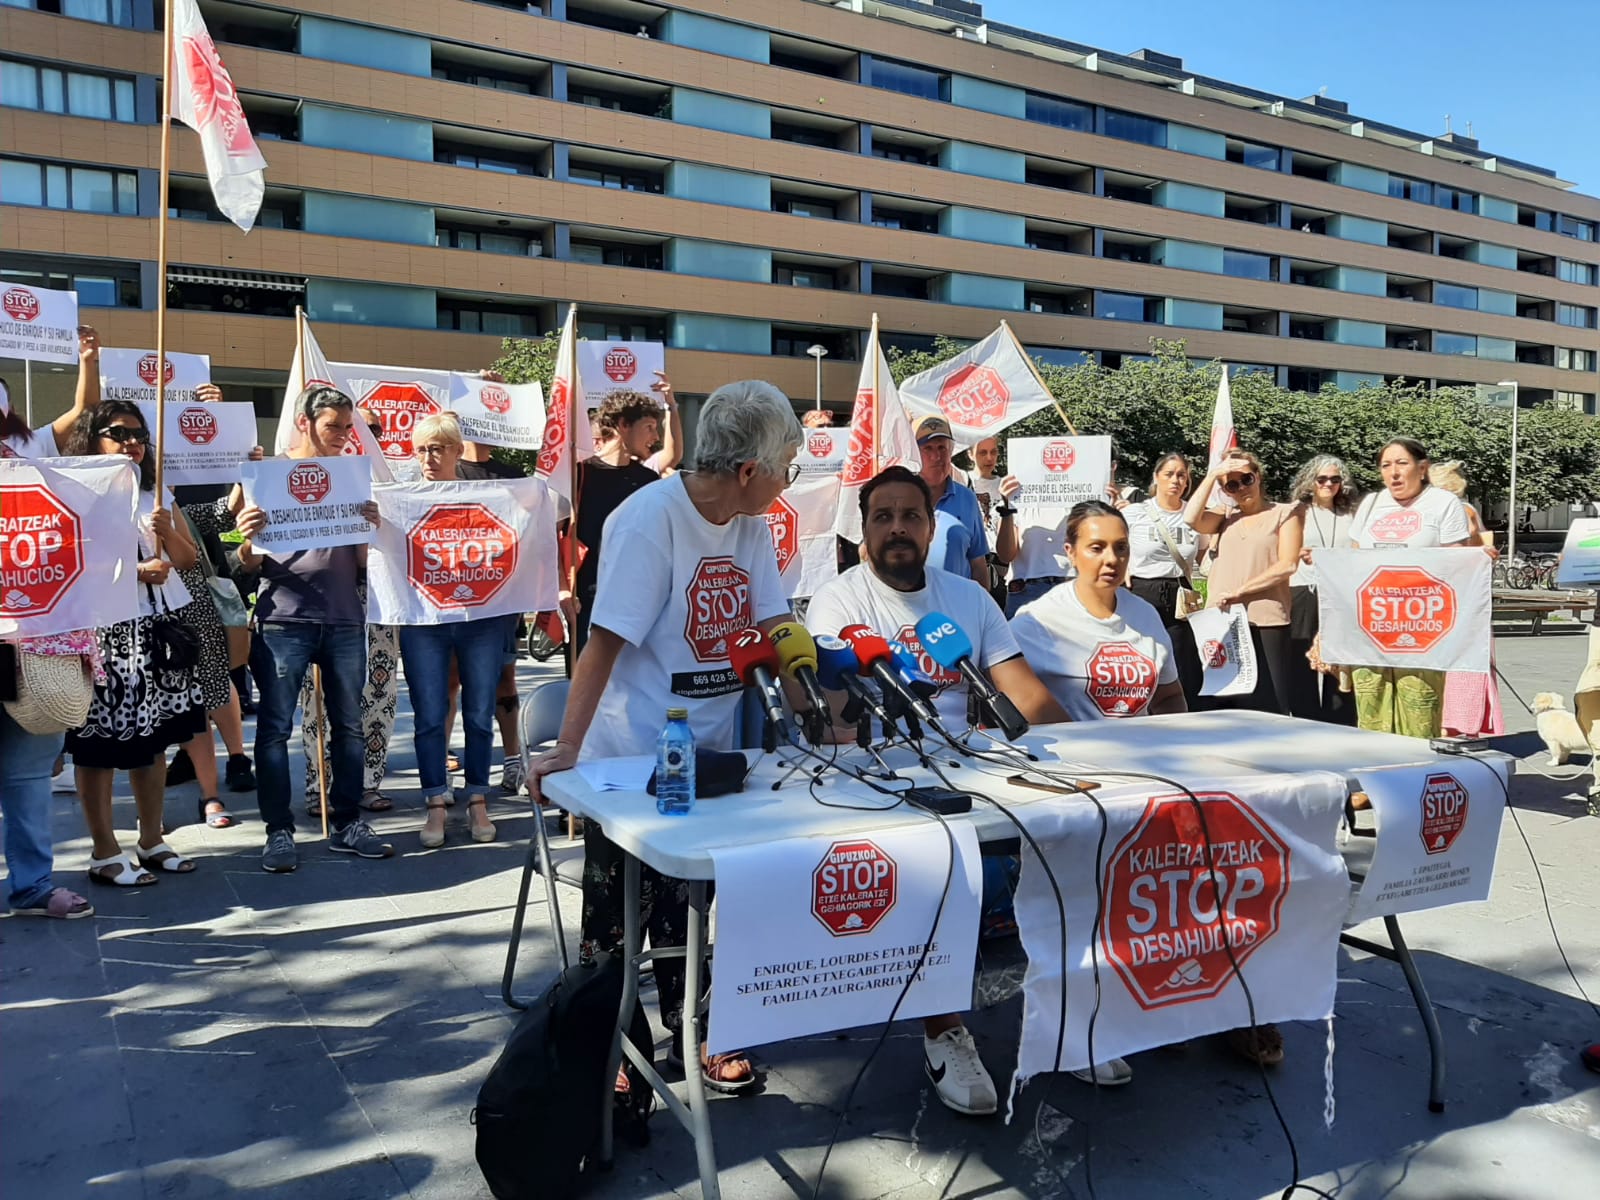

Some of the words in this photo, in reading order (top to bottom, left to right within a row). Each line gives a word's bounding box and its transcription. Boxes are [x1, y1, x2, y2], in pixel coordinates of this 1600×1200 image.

[6, 294, 36, 307] STOP
[607, 355, 634, 367] STOP
[106, 387, 113, 399] NO
[115, 387, 120, 400] AL
[121, 388, 148, 400] DESAHUCIO
[149, 389, 156, 400] DE
[482, 390, 509, 402] STOP
[367, 399, 431, 412] KALERATZEAK
[181, 416, 212, 427] STOP
[462, 416, 490, 431] SUSPENDE
[491, 422, 498, 432] EL
[464, 427, 479, 437] ESTA
[480, 430, 502, 440] FAMILIA
[810, 438, 831, 448] STOP
[1044, 448, 1072, 458] STOP
[292, 471, 326, 486] STOP
[1051, 484, 1058, 493] EL
[1060, 484, 1093, 494] DESAHUCIO
[1040, 495, 1062, 503] FAMILIA
[271, 508, 302, 524] DESAHUCIO
[303, 507, 312, 521] DE
[312, 505, 336, 522] ENRIQUE
[336, 504, 340, 518] Y
[341, 504, 349, 518] SU
[1376, 515, 1417, 526] STOP
[273, 531, 283, 541] POR
[343, 522, 371, 534] VULNERABLES
[420, 527, 502, 541] KALERATZEAK
[423, 540, 504, 571] STOP
[423, 567, 504, 585] DESAHUCIOS
[1368, 585, 1443, 596] KALERATZEAK
[696, 584, 748, 623] STOP
[1370, 597, 1445, 621] STOP
[925, 622, 957, 645] tve
[1370, 620, 1443, 632] DESAHUCIOS
[710, 674, 726, 683] 428
[1095, 661, 1152, 685] STOP
[1095, 686, 1151, 699] DESAHUCIOS
[1425, 790, 1464, 819] STOP
[829, 848, 877, 864] GIPUZKOA
[1129, 839, 1265, 873] KALERATZEAK
[821, 859, 889, 894] STOP
[818, 894, 839, 904] ETXE
[840, 889, 889, 902] KALERATZE
[1126, 867, 1265, 934] STOP
[821, 900, 872, 914] GEHIAGORIK
[1128, 919, 1257, 967] DESAHUCIOS
[754, 960, 817, 978] ENRIQUE,
[820, 950, 879, 968] LOURDES
[882, 947, 905, 959] ETA
[736, 974, 810, 995] SEMEAREN
[928, 953, 951, 967] EZ!!
[762, 989, 818, 1007] FAMILIA
[820, 976, 902, 997] ZAURGARRIA
